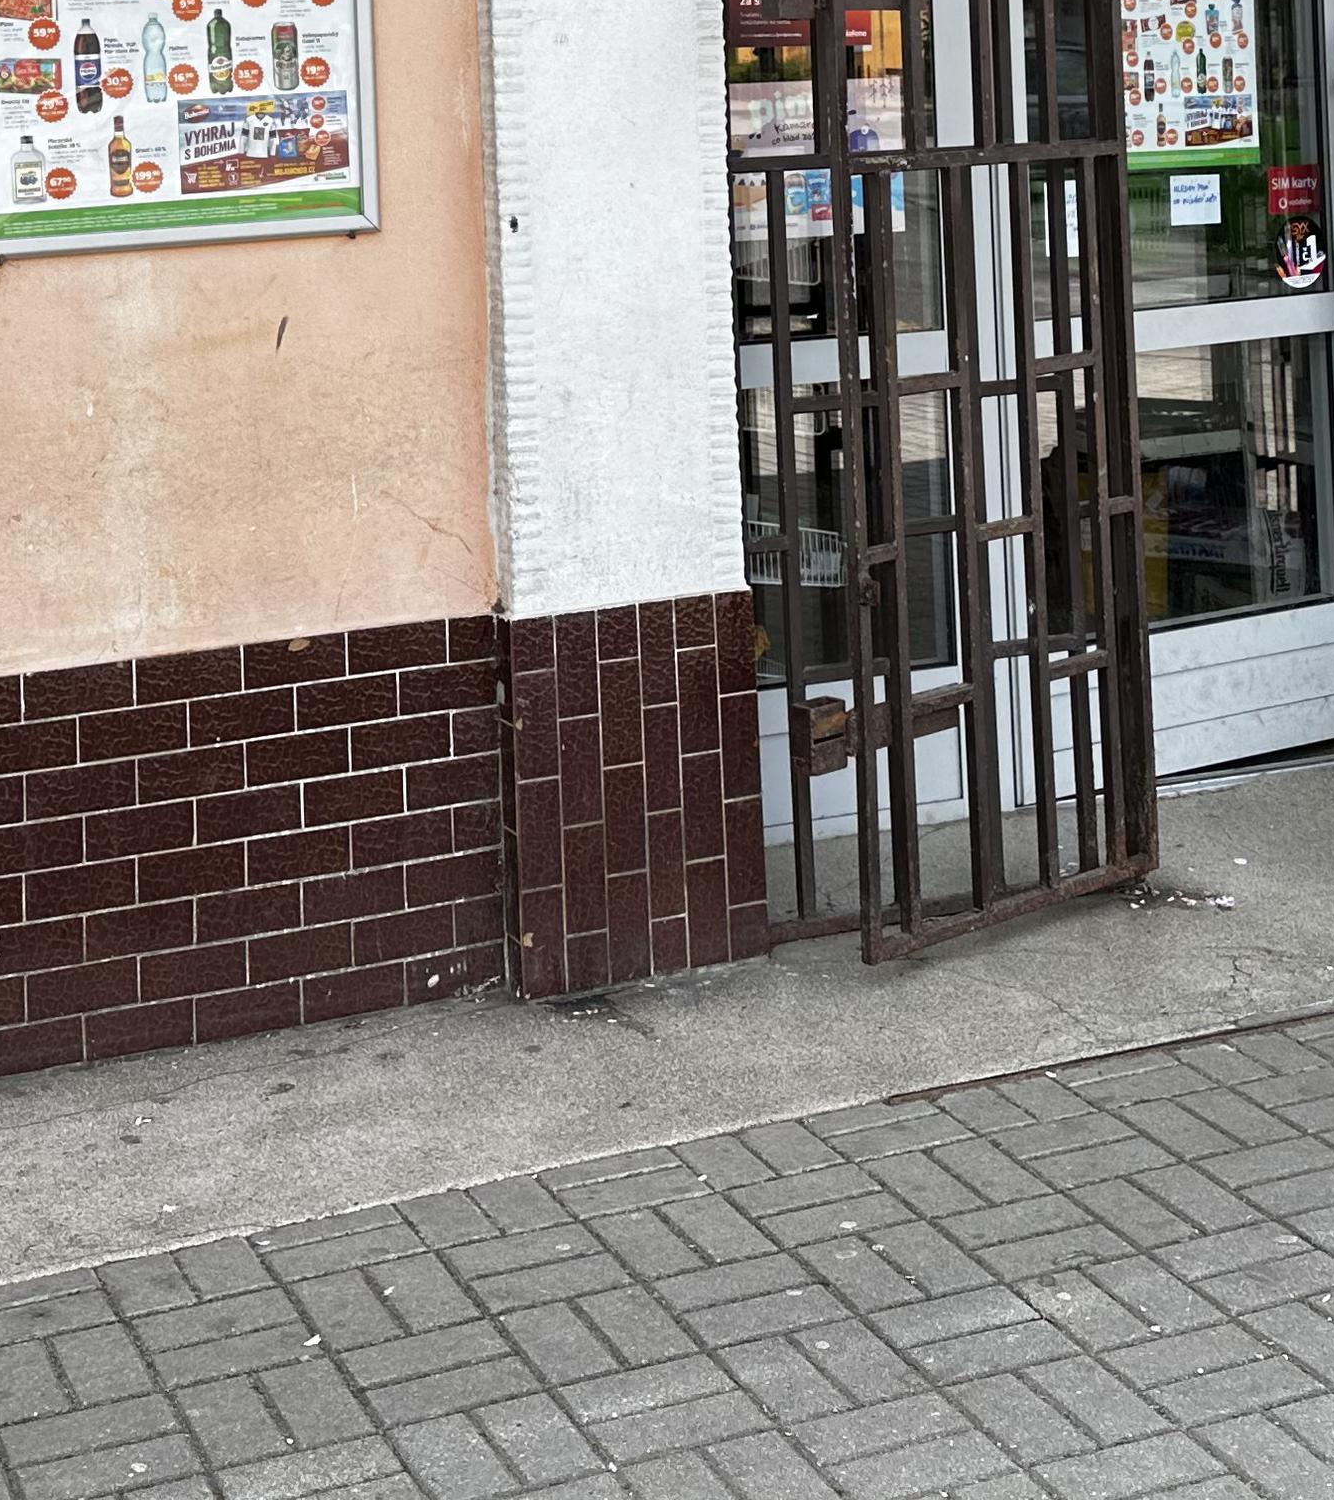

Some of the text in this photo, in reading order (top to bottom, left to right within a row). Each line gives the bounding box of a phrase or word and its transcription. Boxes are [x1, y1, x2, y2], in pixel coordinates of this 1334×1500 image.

[184, 122, 235, 147] VYHRAJ
[184, 139, 237, 160] S BOHEMIA
[1271, 177, 1318, 190] SIM karty
